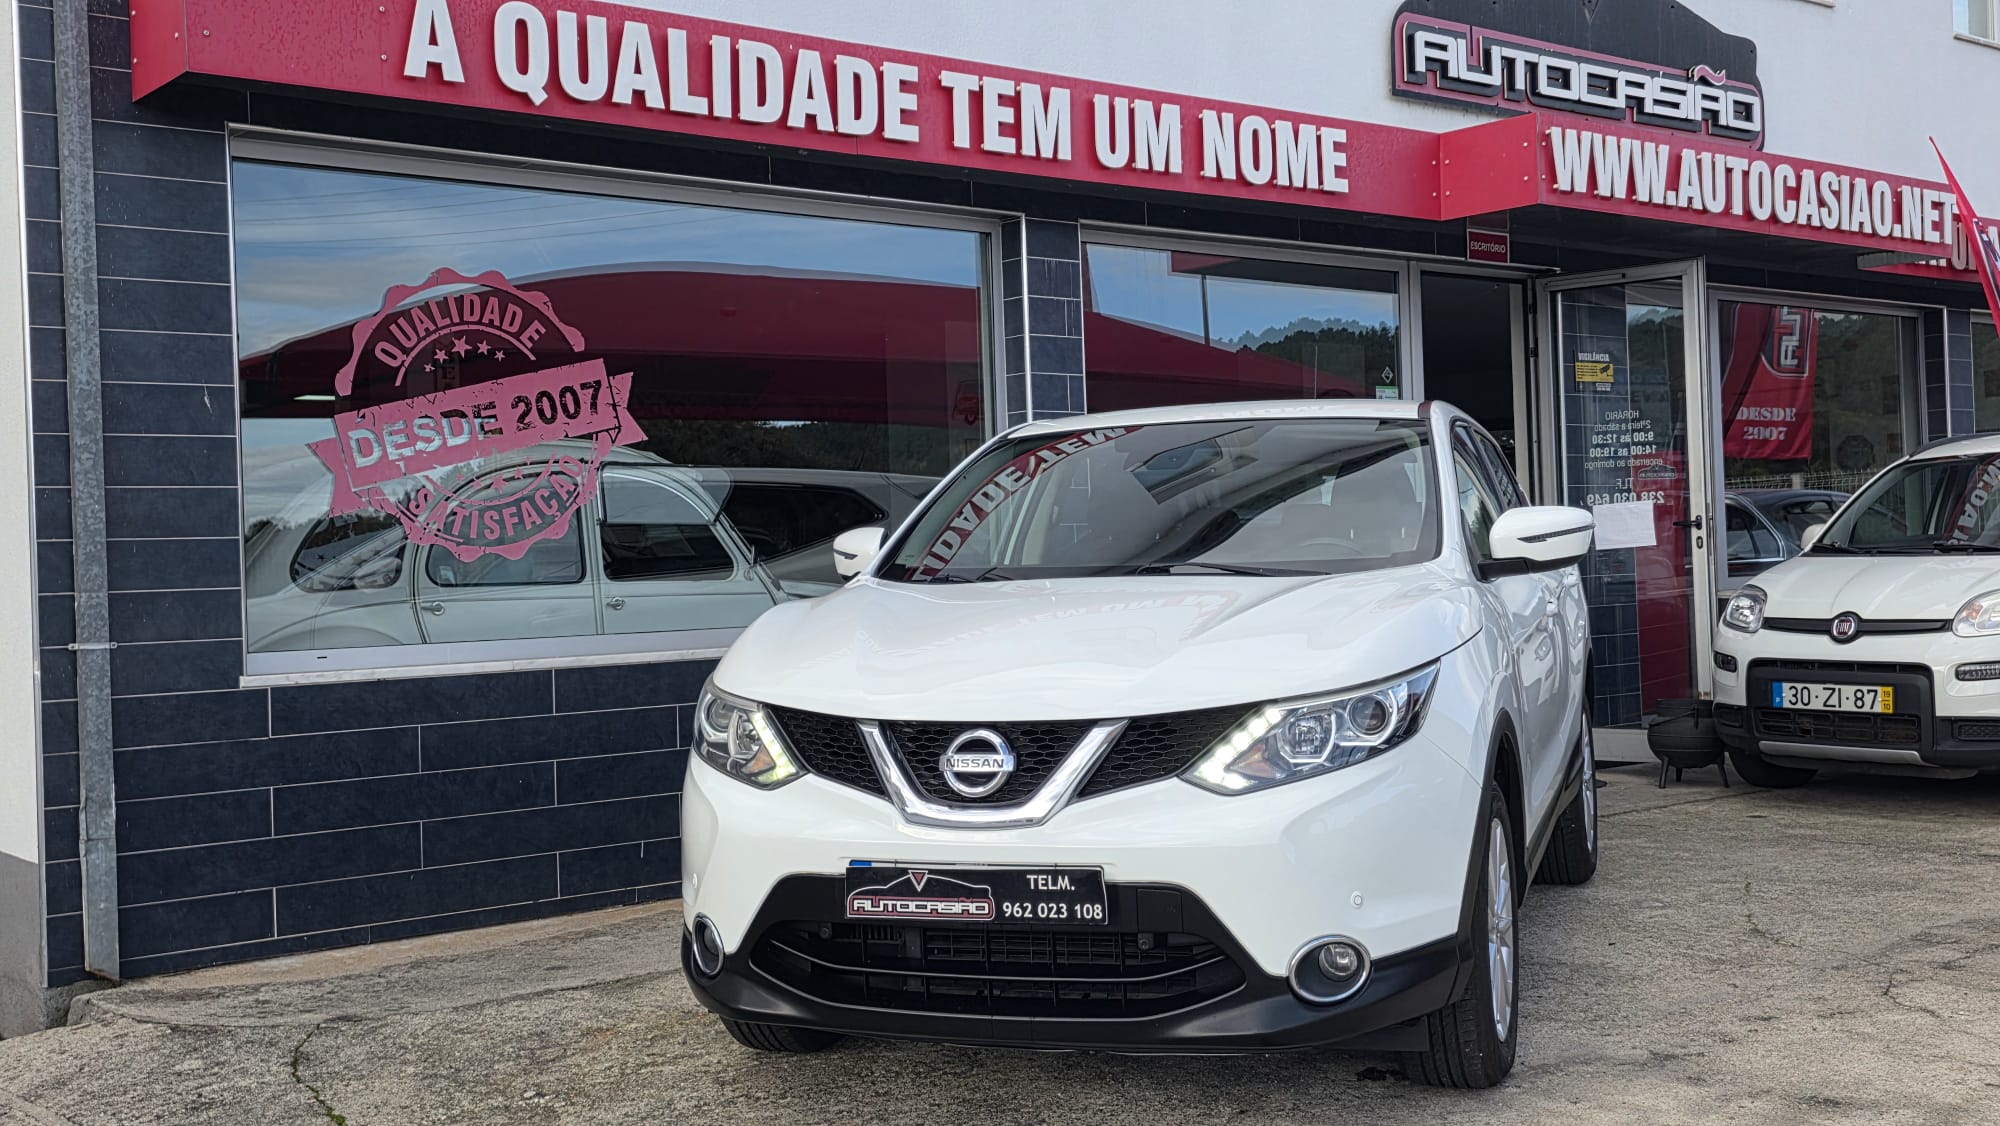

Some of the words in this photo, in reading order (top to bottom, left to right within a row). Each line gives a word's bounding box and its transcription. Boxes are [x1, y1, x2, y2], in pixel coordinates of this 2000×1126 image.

[403, 0, 465, 83] A
[494, 0, 920, 143] QUALIDADE
[941, 70, 1071, 160] TEM
[1094, 93, 1182, 174] UM
[1202, 109, 1349, 193] NOME
[1550, 126, 1957, 245] WWW.AUTOCASIAO.NET
[1470, 241, 1506, 253] ESCRITÓRIO
[374, 293, 547, 368] QUALIDADE
[1736, 407, 1796, 421] DESDE
[347, 401, 504, 468] DESDE
[511, 380, 602, 432] 2007
[1744, 426, 1788, 441] 2007
[945, 758, 1005, 768] NISSAN
[1026, 874, 1076, 891] TELM.
[1002, 902, 1033, 918] 962
[1037, 903, 1068, 918] 023
[1074, 903, 1103, 919] 108
